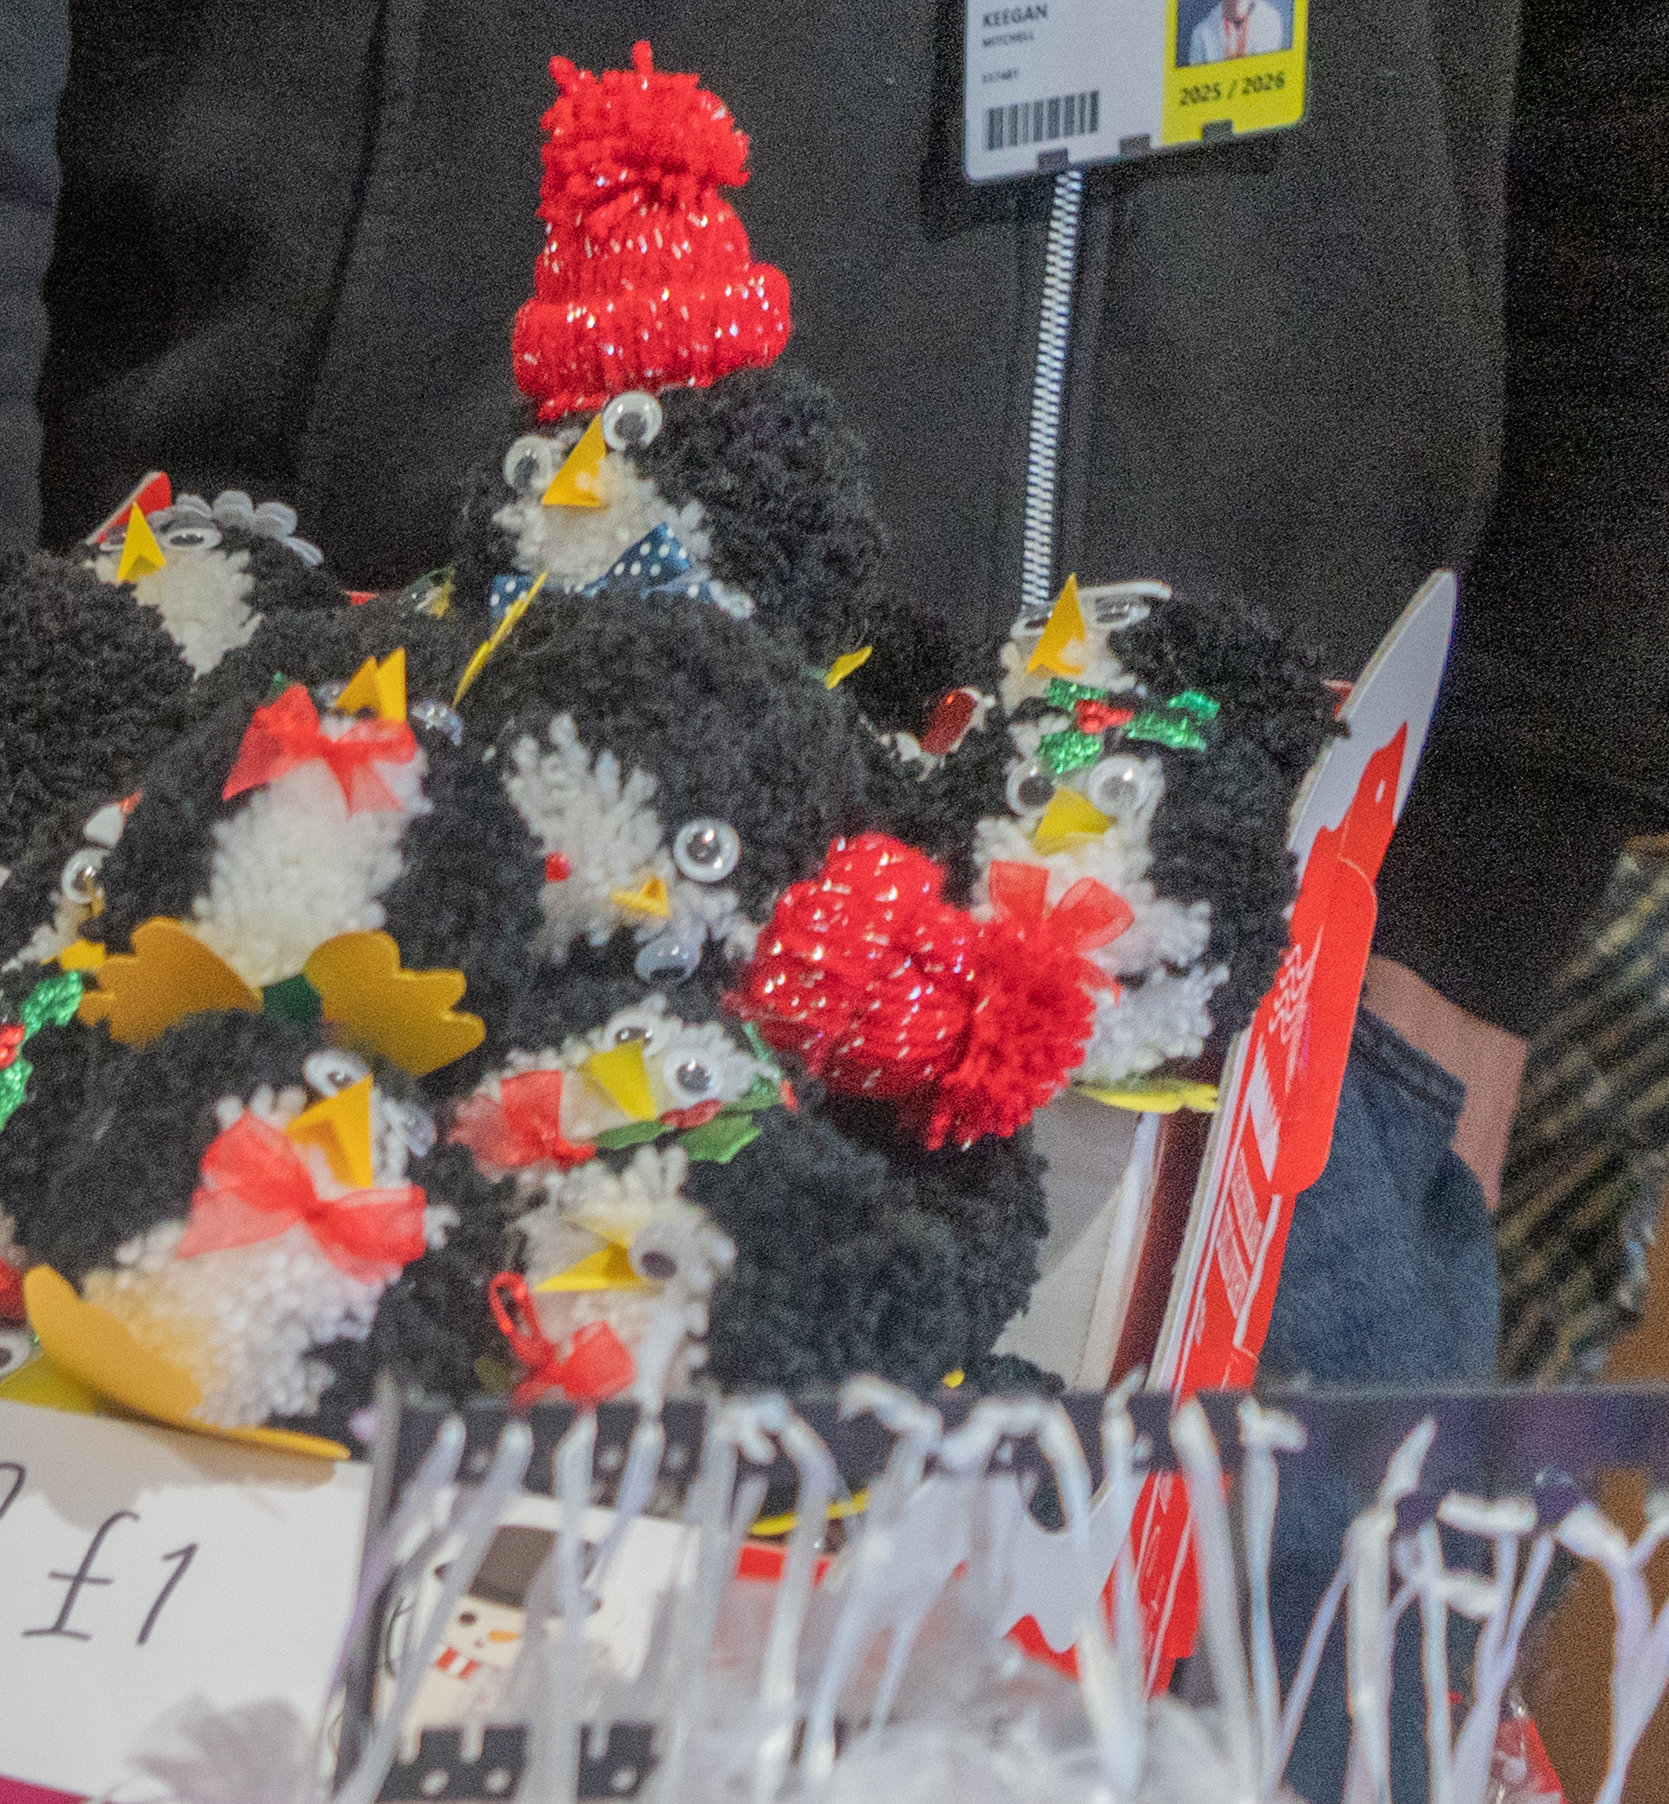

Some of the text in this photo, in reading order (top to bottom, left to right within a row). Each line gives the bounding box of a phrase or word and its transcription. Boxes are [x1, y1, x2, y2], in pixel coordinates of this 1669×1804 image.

[1179, 82, 1221, 106] 2025
[1242, 70, 1285, 95] 2026
[20, 1509, 199, 1647] £1
